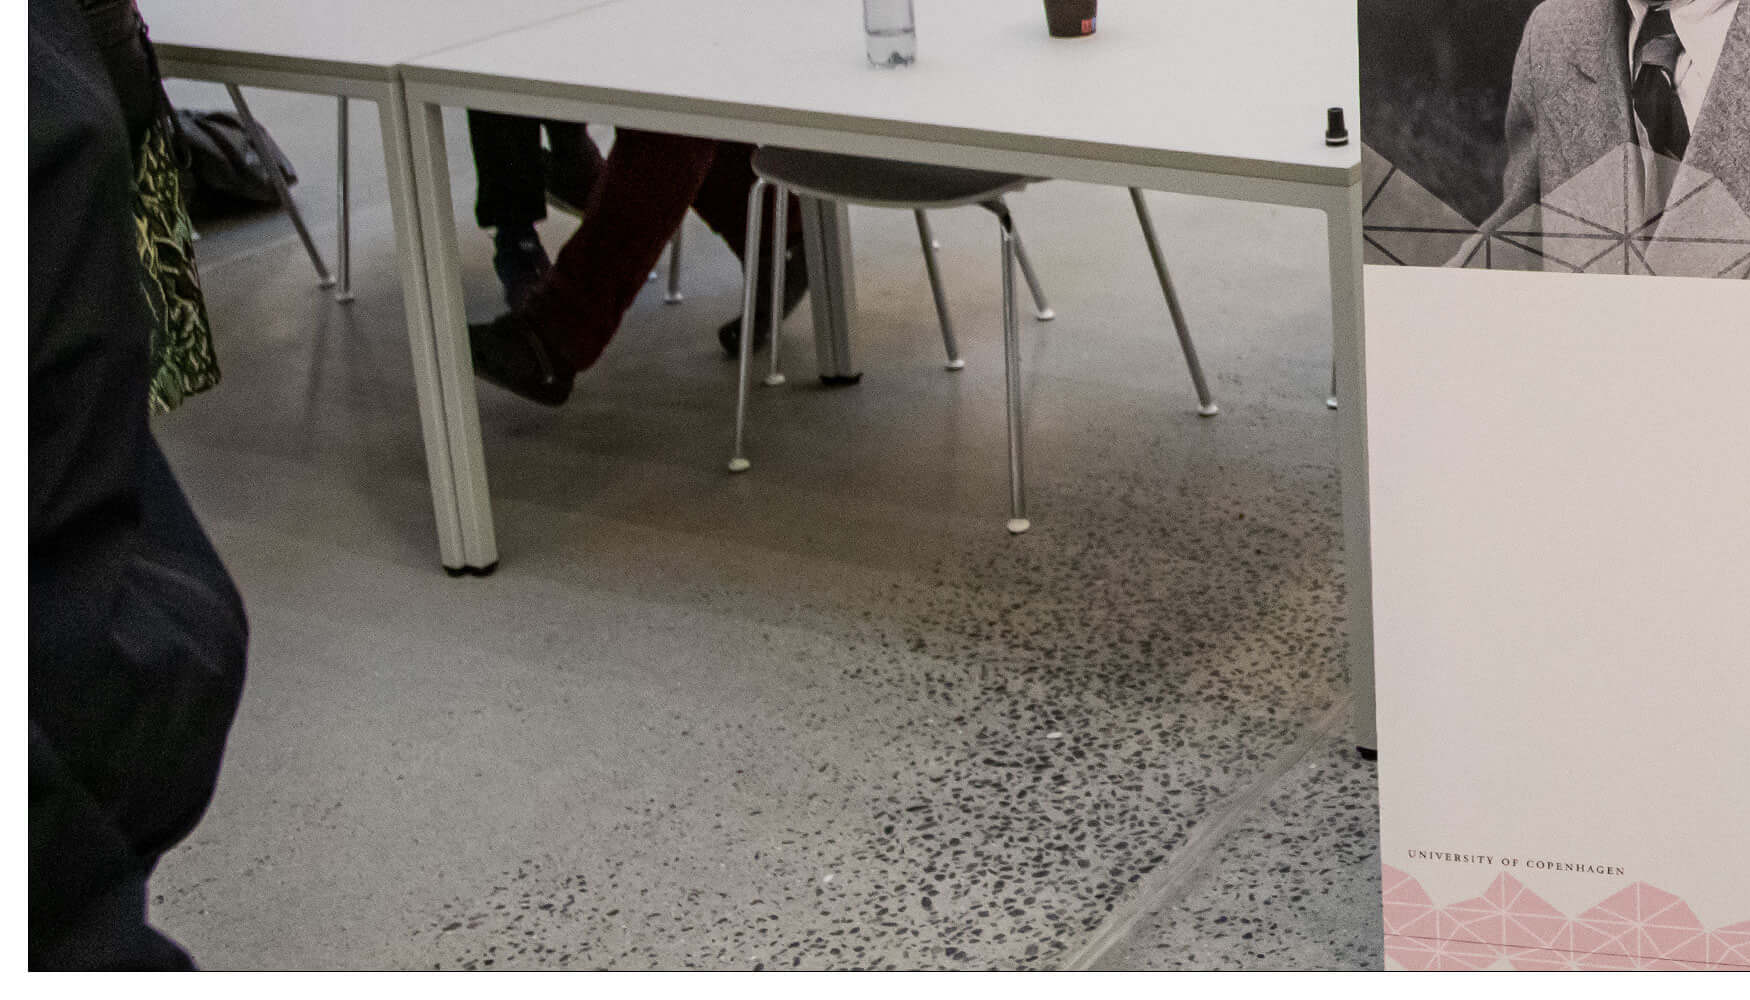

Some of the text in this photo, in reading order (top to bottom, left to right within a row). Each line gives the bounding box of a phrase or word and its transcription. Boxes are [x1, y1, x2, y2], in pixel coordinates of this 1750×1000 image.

[1408, 849, 1624, 876] UNIVERSITY OF COPENHAGEN
